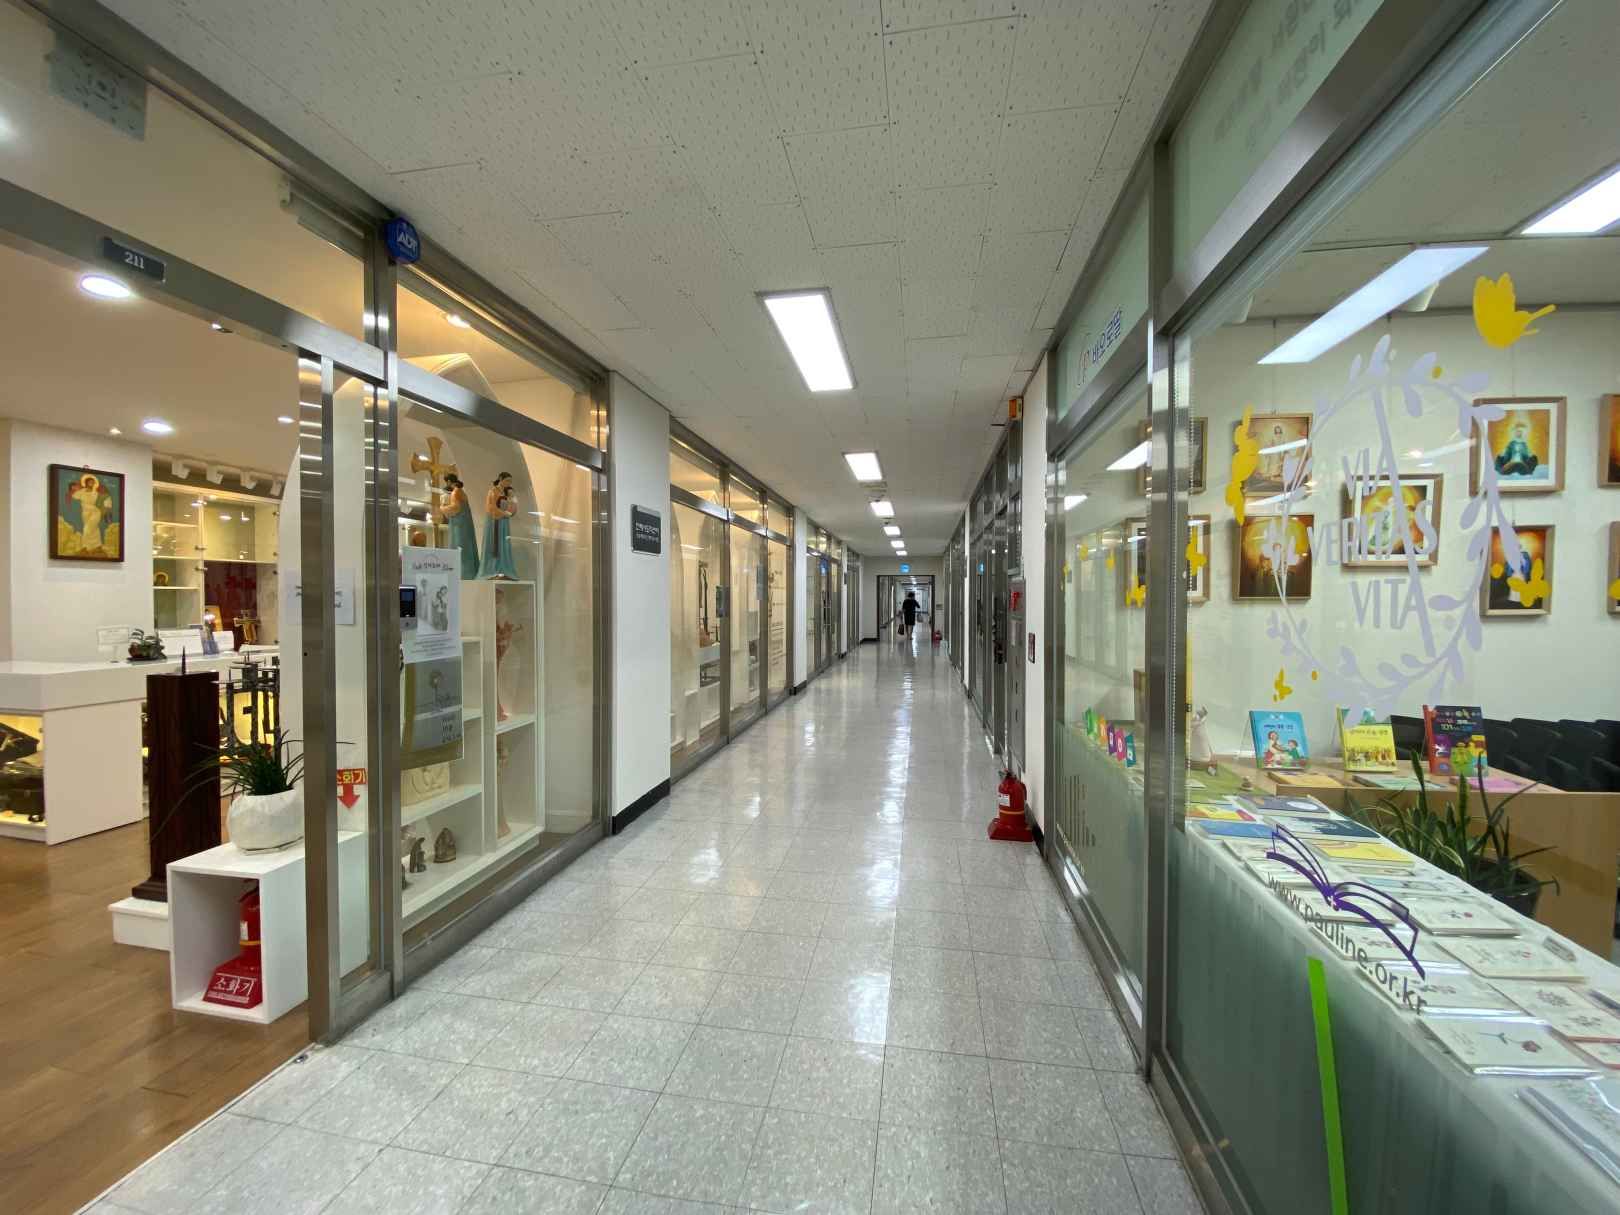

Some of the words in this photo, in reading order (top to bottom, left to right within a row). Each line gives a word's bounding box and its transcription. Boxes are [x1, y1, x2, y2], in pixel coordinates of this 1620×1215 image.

[123, 251, 145, 269] 211
[396, 231, 418, 254] ADT
[1342, 446, 1401, 500] VIA
[1306, 498, 1438, 567] VERITAS
[1349, 577, 1427, 630] VITA
[1267, 871, 1429, 1016] www.pauline.or.kr
[212, 975, 255, 997] 소화기
